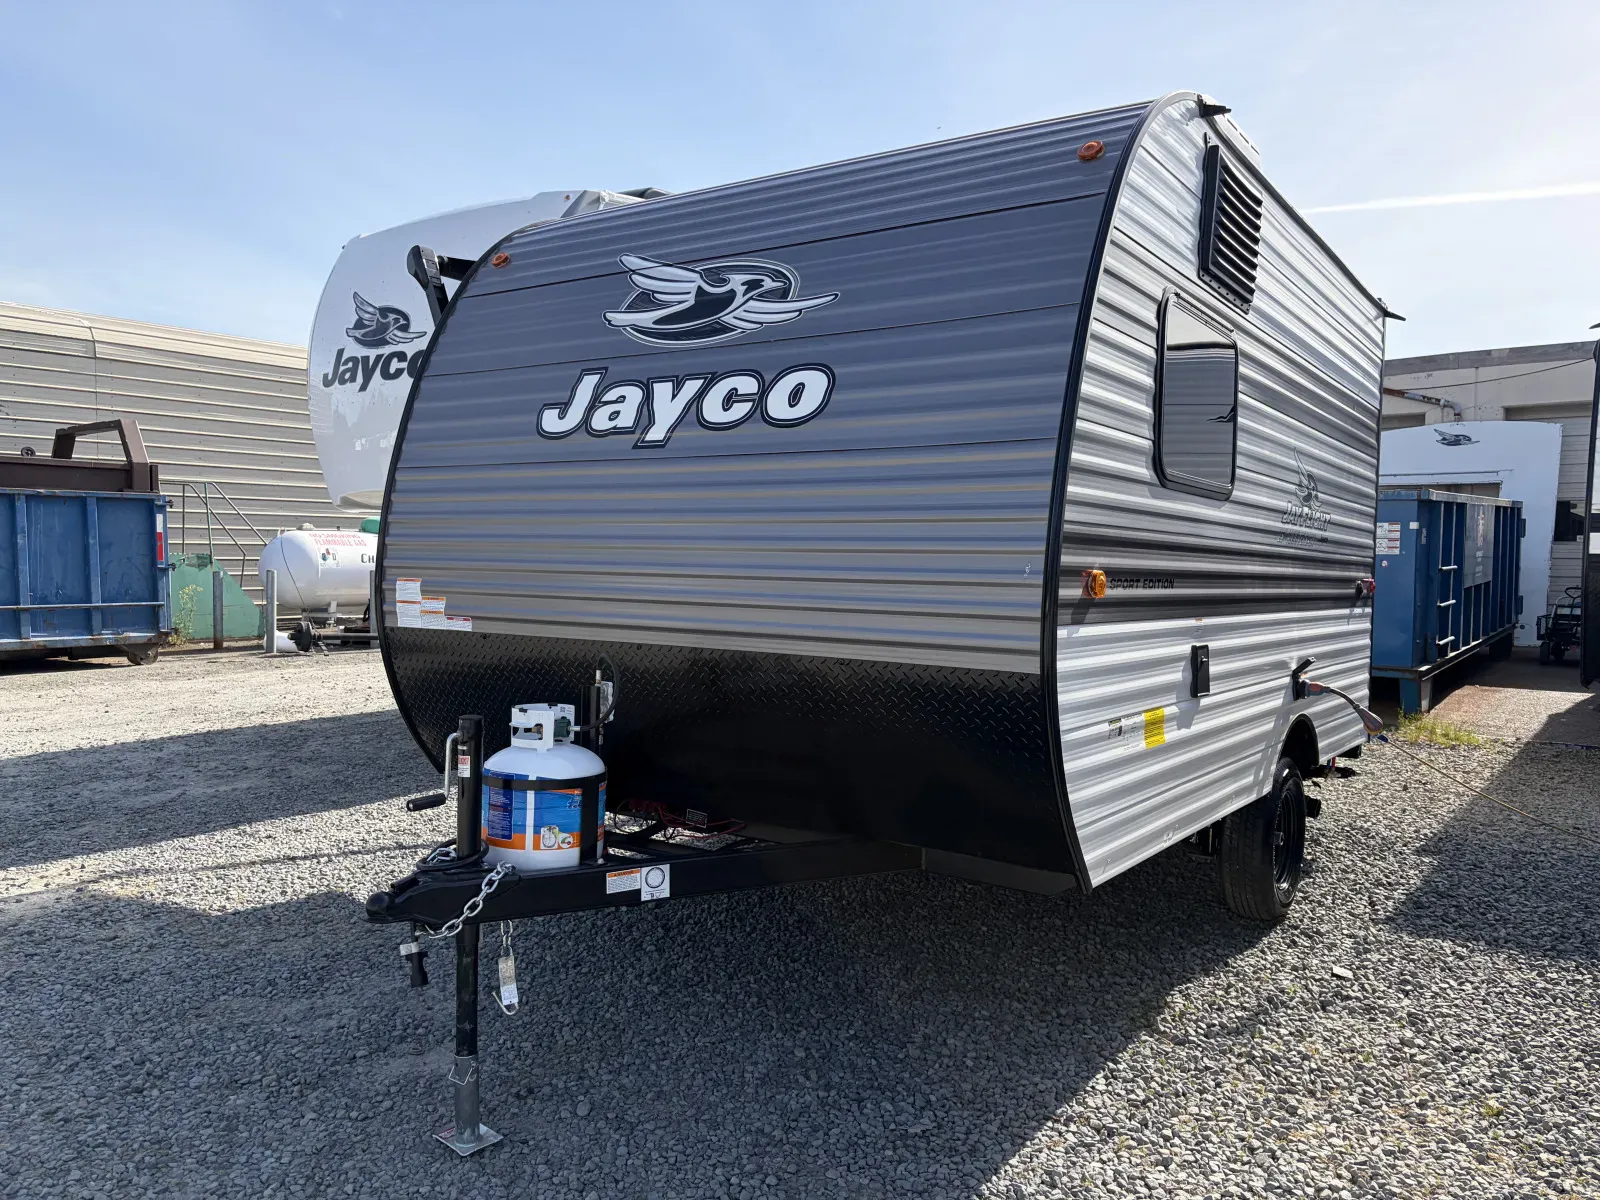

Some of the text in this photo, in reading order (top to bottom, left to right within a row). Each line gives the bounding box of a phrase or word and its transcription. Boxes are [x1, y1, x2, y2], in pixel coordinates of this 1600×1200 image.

[536, 362, 836, 449] Jayco
[314, 539, 353, 547] FLAMMABLE
[1110, 578, 1175, 590] SPORT EDITION
